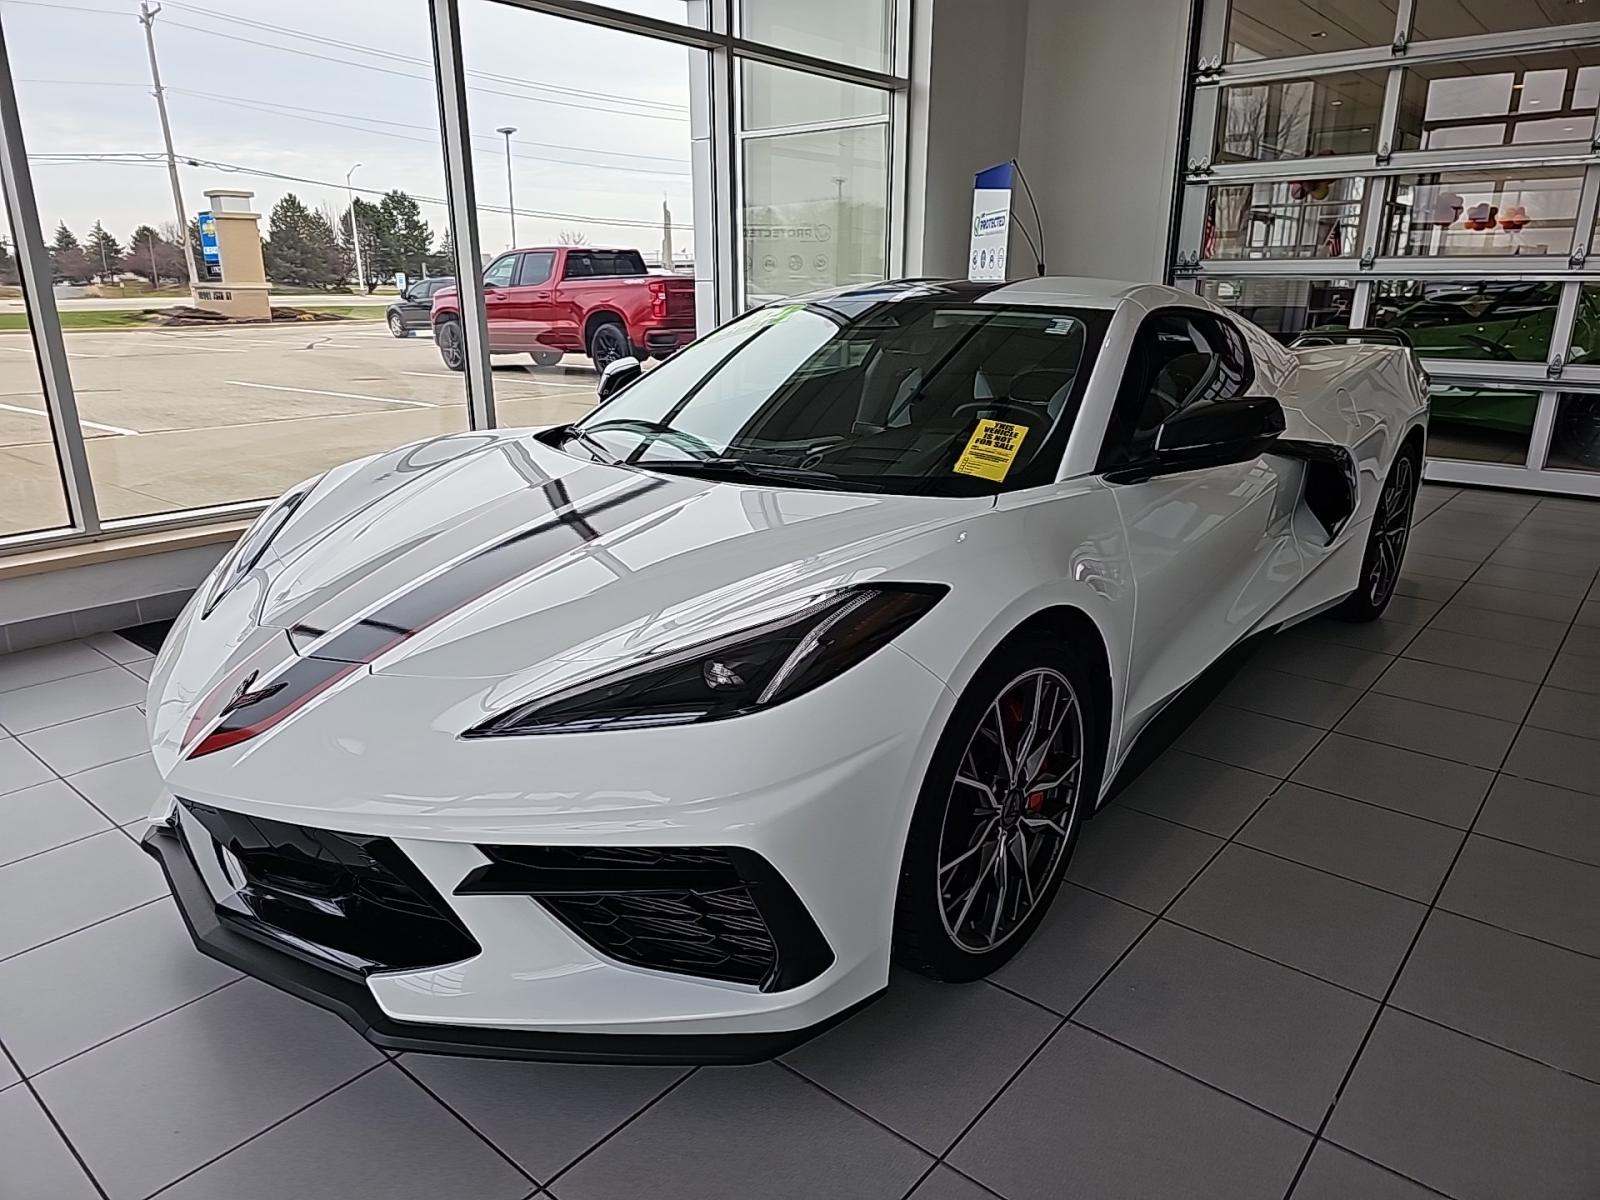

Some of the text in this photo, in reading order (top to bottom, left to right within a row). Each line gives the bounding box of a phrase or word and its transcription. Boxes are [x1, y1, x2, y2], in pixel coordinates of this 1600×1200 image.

[995, 422, 1015, 431] THIS
[984, 426, 1019, 438] VEHICLE
[994, 435, 1012, 443] NOT
[975, 438, 1015, 451] FOR SALE
